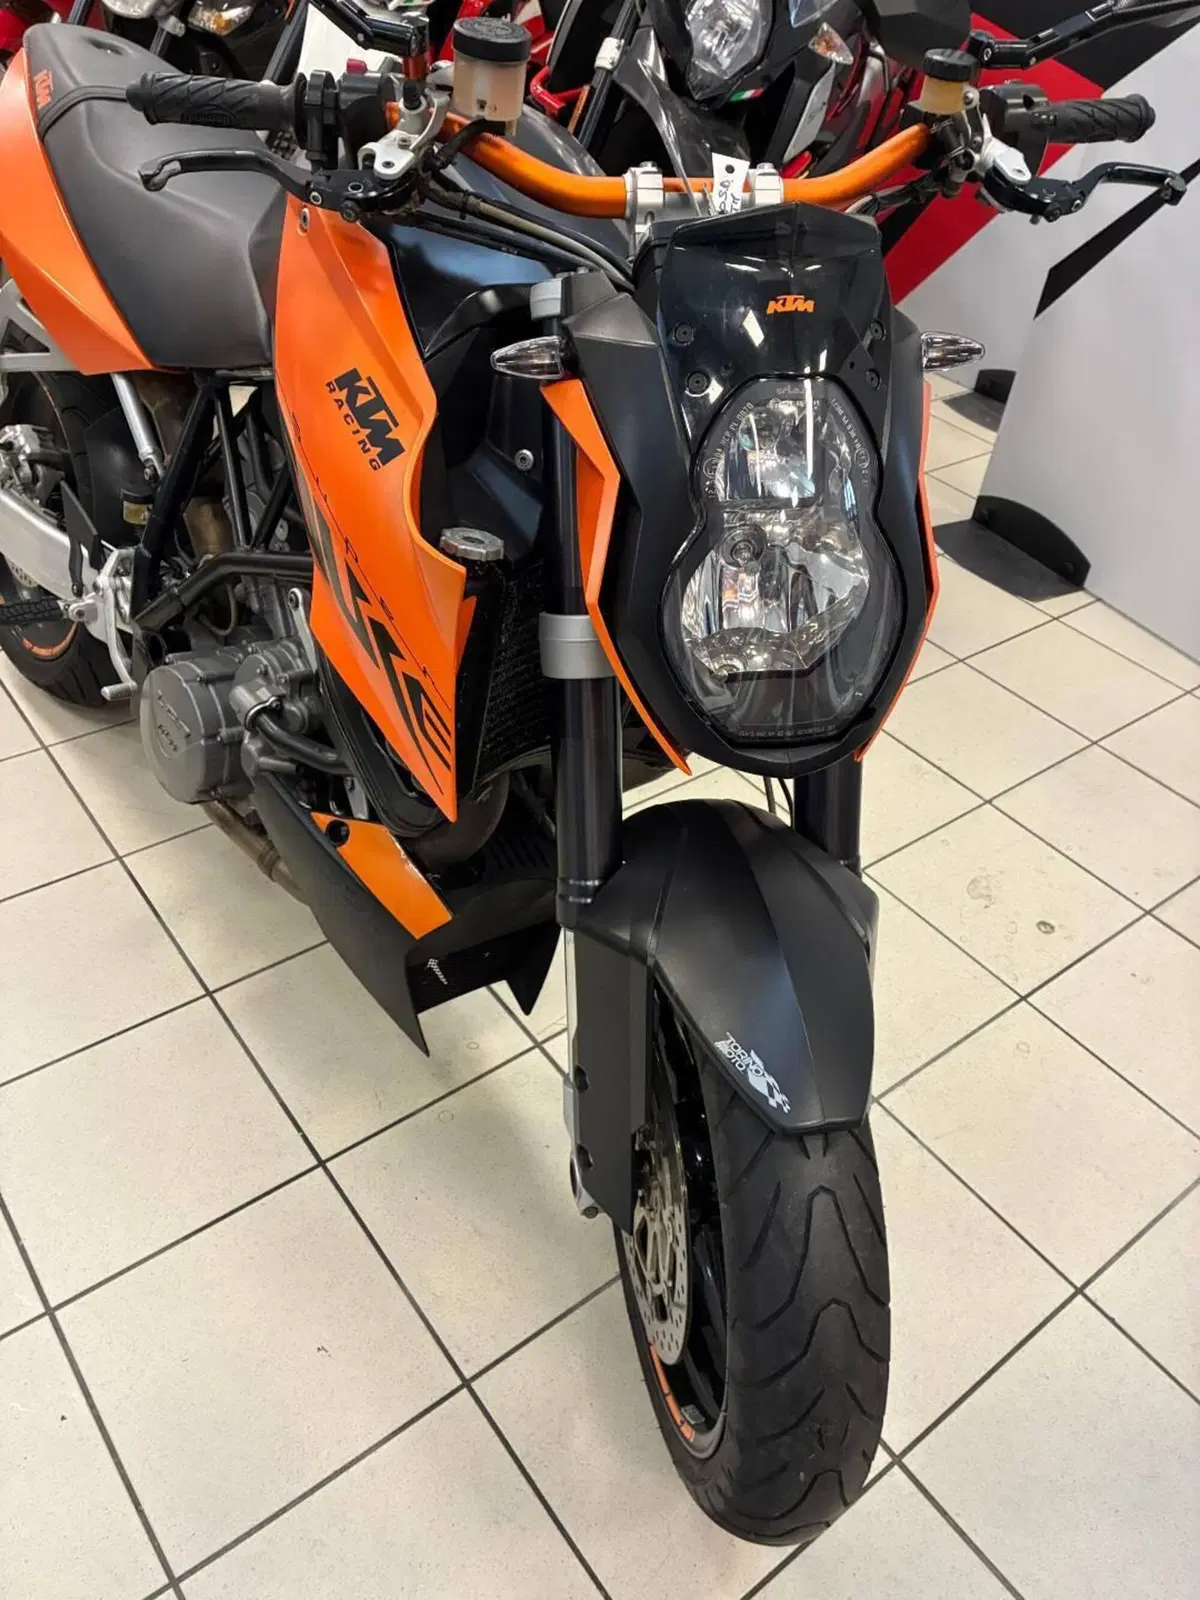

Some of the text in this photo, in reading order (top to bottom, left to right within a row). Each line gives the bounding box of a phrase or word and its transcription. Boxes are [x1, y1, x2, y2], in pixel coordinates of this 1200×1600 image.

[33, 69, 53, 110] KTM
[766, 294, 815, 315] KTM
[325, 381, 381, 471] RACING
[334, 367, 405, 467] KTM
[726, 1031, 764, 1077] TORINO
